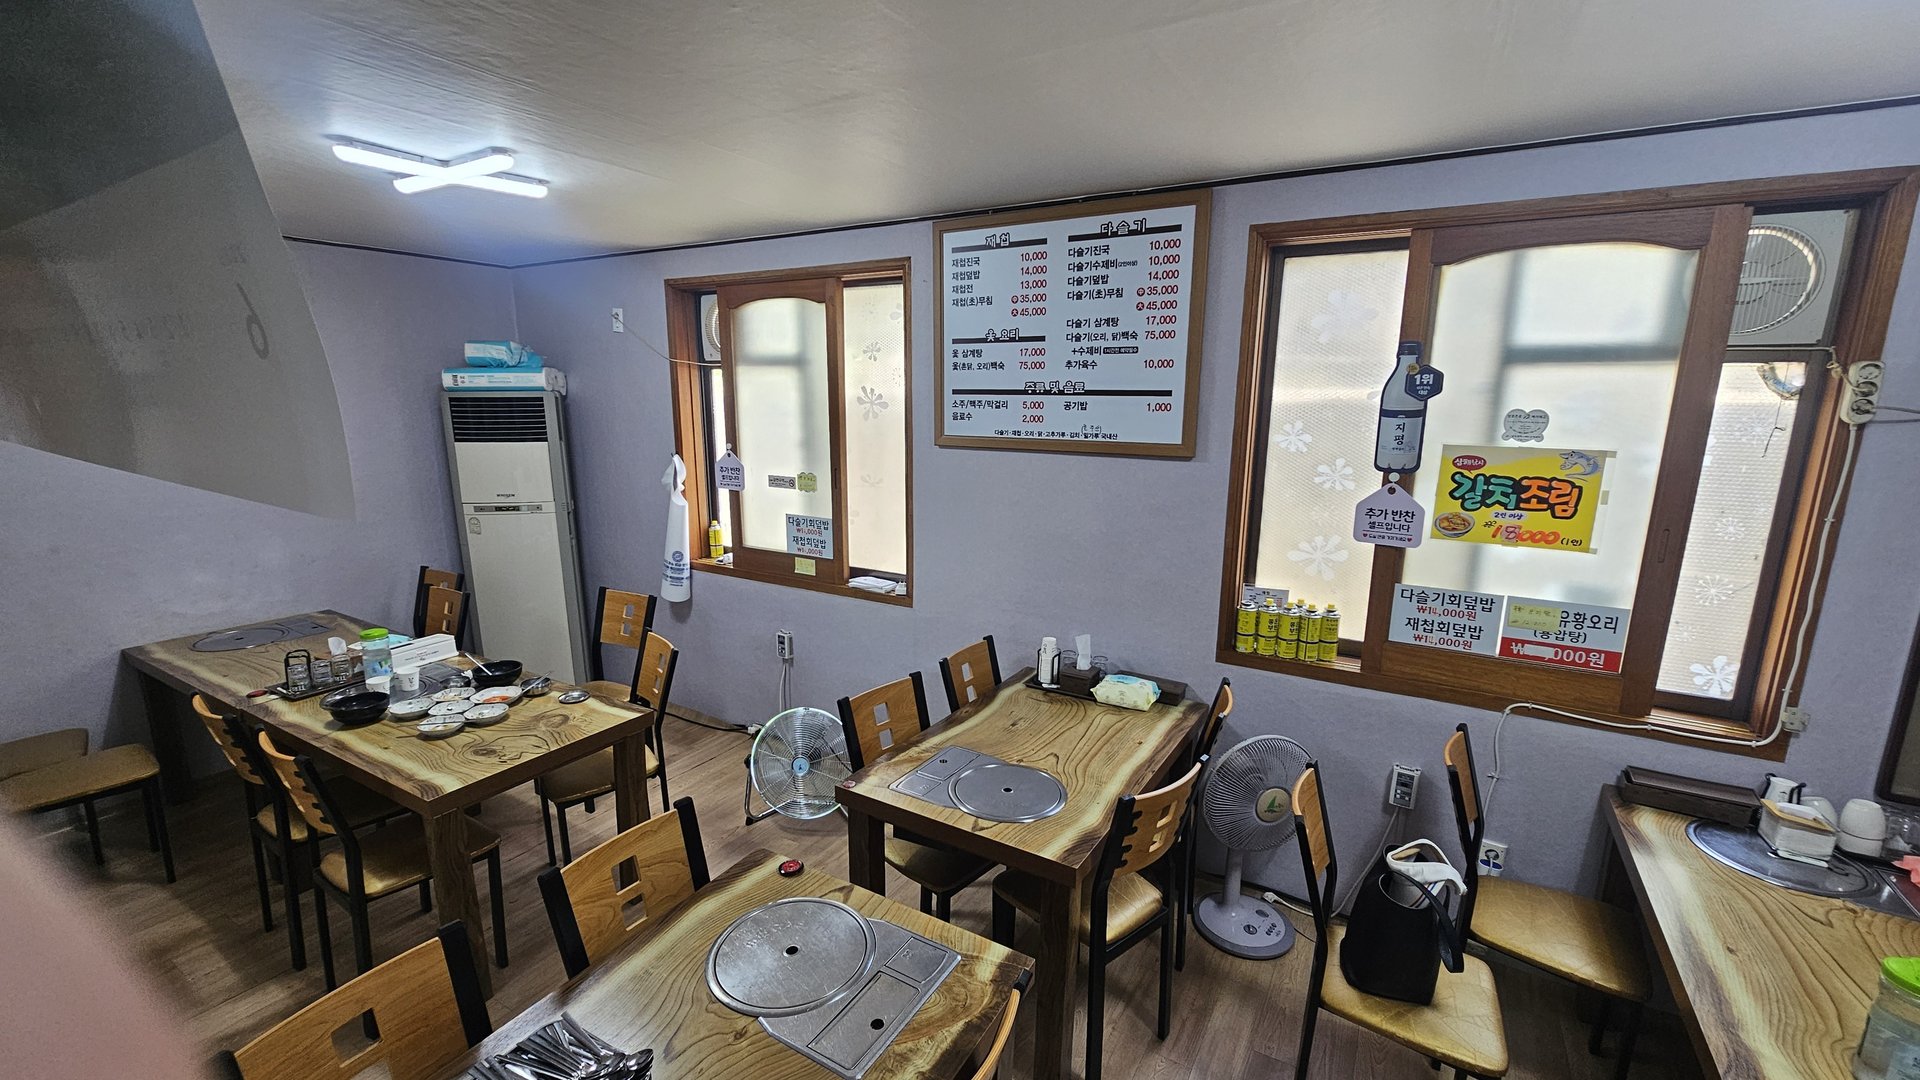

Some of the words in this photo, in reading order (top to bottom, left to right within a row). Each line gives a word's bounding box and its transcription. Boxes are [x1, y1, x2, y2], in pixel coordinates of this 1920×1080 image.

[1100, 218, 1147, 236] 다슬기
[985, 232, 1010, 248] 재첩
[1068, 244, 1110, 258] 다슬기진국
[1149, 238, 1181, 251] 10,000
[952, 257, 980, 267] 재첩진국
[1021, 251, 1048, 262] 10,000
[1149, 254, 1180, 266] 10,000
[952, 270, 980, 281] 재첩덮밥
[1021, 265, 1047, 276] 14,000
[1067, 274, 1110, 287] 다슬기덮밥
[1148, 269, 1179, 281] 14,000
[952, 284, 974, 294] 재첩전
[1021, 279, 1047, 290] 13,000
[1067, 287, 1124, 301] 다슬기(초)무침
[1146, 285, 1178, 296] 35,000
[952, 296, 993, 307] 재첩(초)무침
[1020, 293, 1047, 303] 35,000
[1146, 300, 1178, 311] 45,000
[1020, 307, 1047, 317] 45,000
[1066, 319, 1091, 329] 다슬기
[1094, 317, 1120, 328] 삼계탕
[1145, 315, 1177, 326] 17,000
[1000, 328, 1020, 341] 요리
[1066, 332, 1109, 343] 다슬기(오리,
[1111, 331, 1139, 341] 닭)백숙
[1144, 330, 1176, 341] 75,000
[962, 348, 983, 358] 삼계탕
[1019, 348, 1046, 357] 17,000
[1071, 346, 1102, 356] +수제비
[1019, 361, 1046, 370] 75,000
[1065, 360, 1098, 370] 추가육수
[1143, 359, 1174, 369] 10,000
[1414, 373, 1434, 385] 1위
[1024, 381, 1046, 393] 주류
[1049, 380, 1060, 393] 및
[1063, 380, 1086, 393] 음료
[952, 399, 1009, 410] 소주/맥주/막걸리
[1022, 401, 1044, 410] 5,000
[1063, 401, 1088, 411] 공기밥
[1146, 402, 1172, 413] 1,000
[952, 411, 973, 421] 음료수
[1022, 415, 1044, 424] 2,000
[1393, 422, 1406, 446] 지평
[1449, 471, 1583, 520] 갈치조림
[1365, 507, 1389, 520] 추가
[1391, 509, 1416, 523] 반찬
[1493, 511, 1507, 519] 2인
[1508, 512, 1524, 521] 이상
[788, 516, 829, 531] 다슬기회덮밥
[1368, 520, 1411, 533] 셀프입니다
[792, 535, 827, 549] 재첩회덮밥
[1400, 588, 1496, 613] 다슬기회덮밥
[1416, 605, 1477, 622] ₩14,000원
[1405, 617, 1485, 641] 재첩회덮밥
[1510, 642, 1605, 668] ₩,000원
